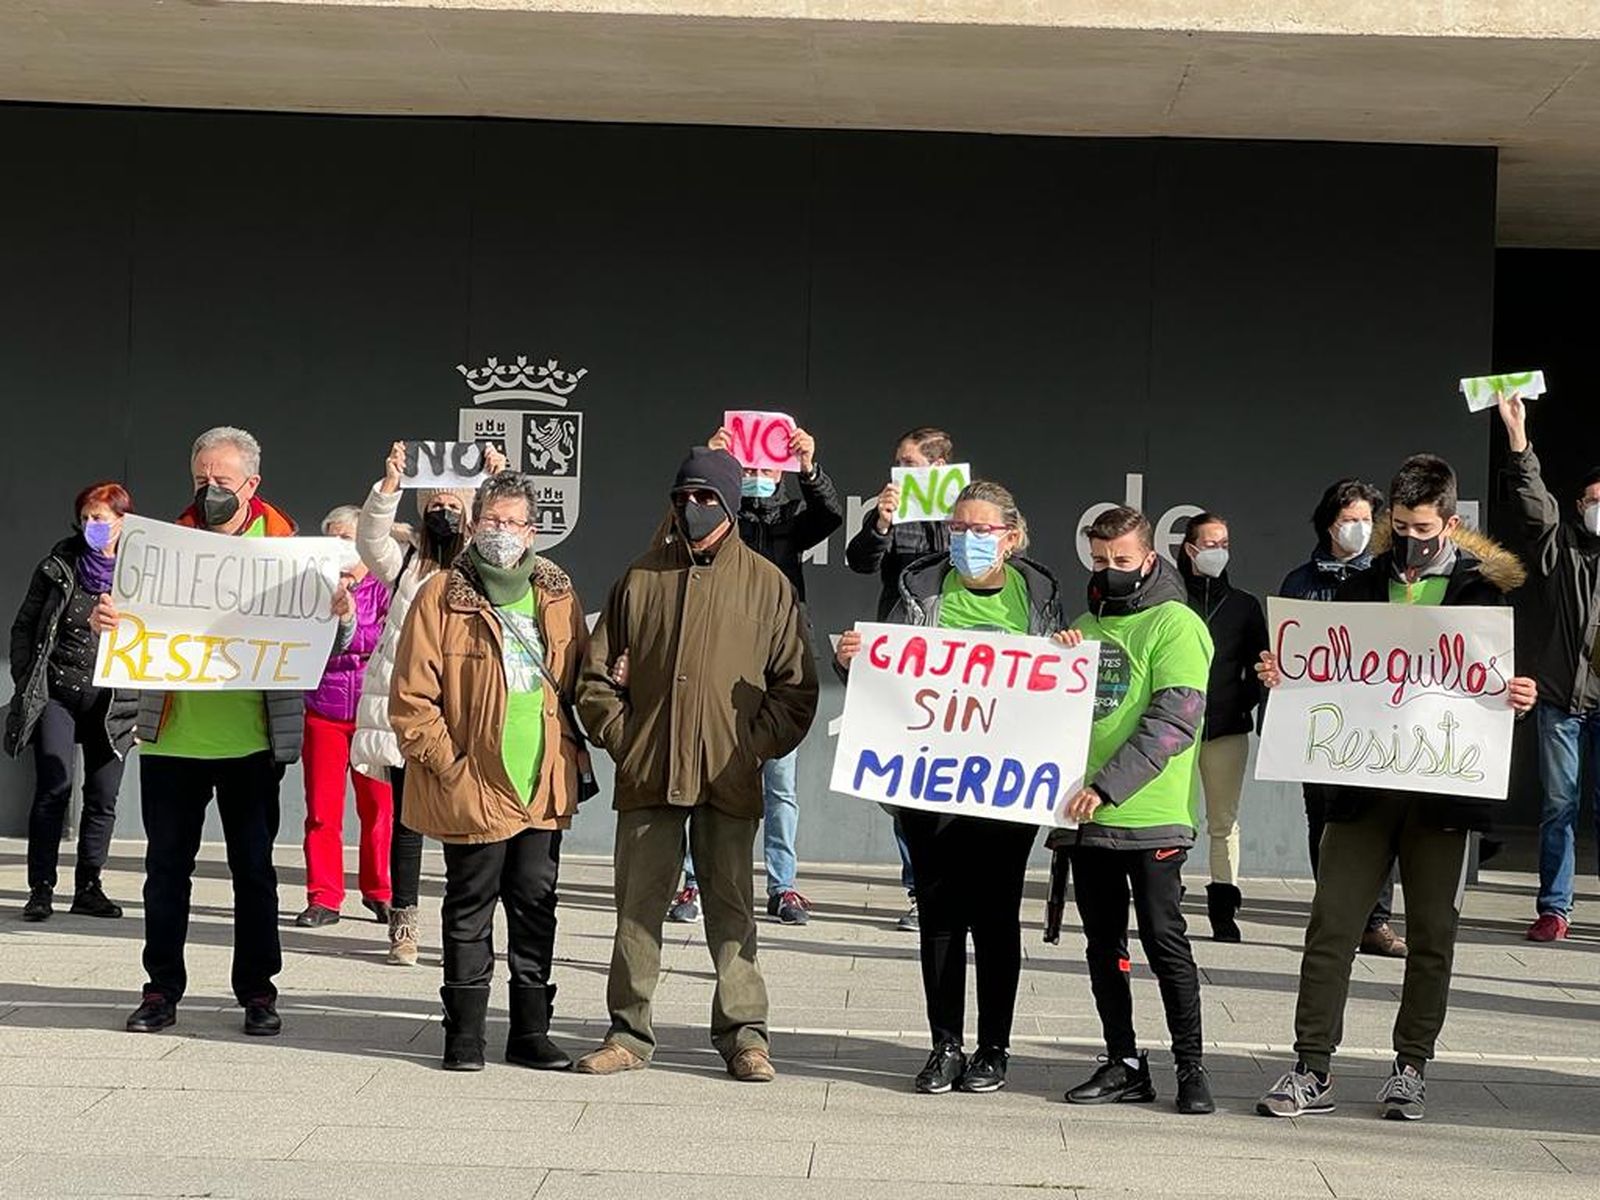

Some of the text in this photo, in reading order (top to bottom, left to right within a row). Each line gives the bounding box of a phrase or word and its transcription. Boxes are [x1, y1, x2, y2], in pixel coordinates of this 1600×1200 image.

[403, 440, 485, 477] NO
[730, 416, 794, 462] NO
[898, 468, 966, 519] NO
[101, 612, 311, 682] RESISTE
[1277, 620, 1507, 706] Galleguillos
[1307, 703, 1486, 782] Resiste
